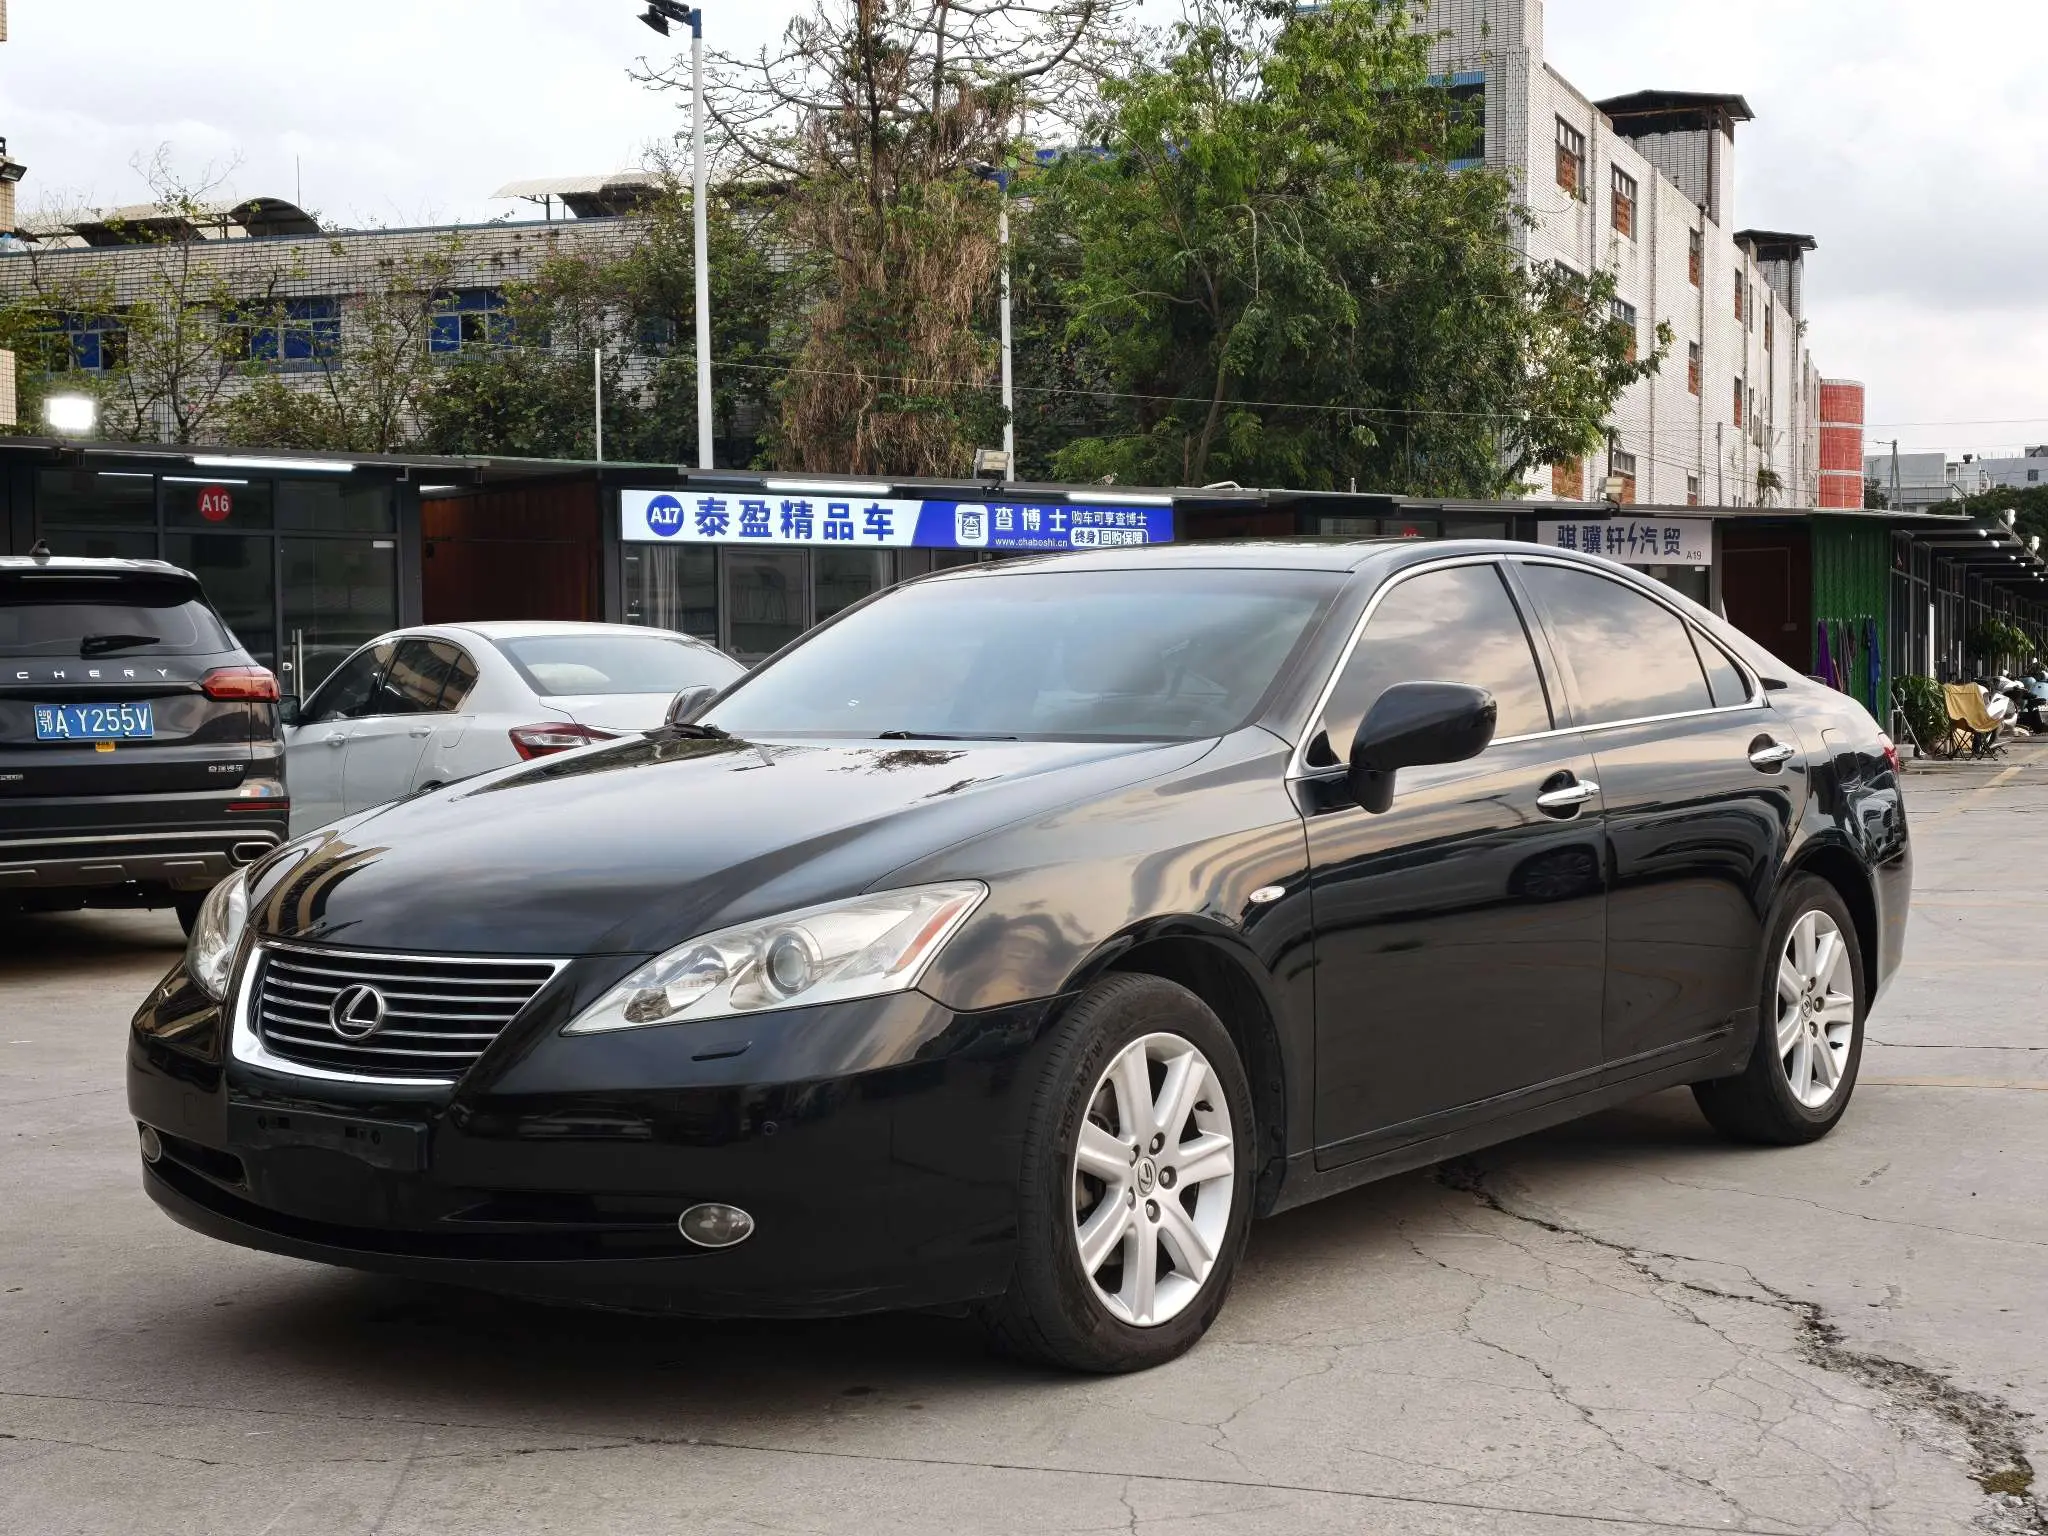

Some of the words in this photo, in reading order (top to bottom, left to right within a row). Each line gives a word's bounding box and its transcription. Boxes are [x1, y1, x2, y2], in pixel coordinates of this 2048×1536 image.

[201, 493, 229, 512] A16
[650, 507, 680, 523] A17
[694, 496, 894, 541] 泰盈精品车
[994, 507, 1067, 532] 查博士
[1071, 510, 1147, 526] 购车可享查博士
[995, 537, 1068, 548] www.chaboshi.cn
[1074, 529, 1096, 544] 终身
[1686, 551, 1702, 561] A19
[16, 668, 168, 680] CHERY
